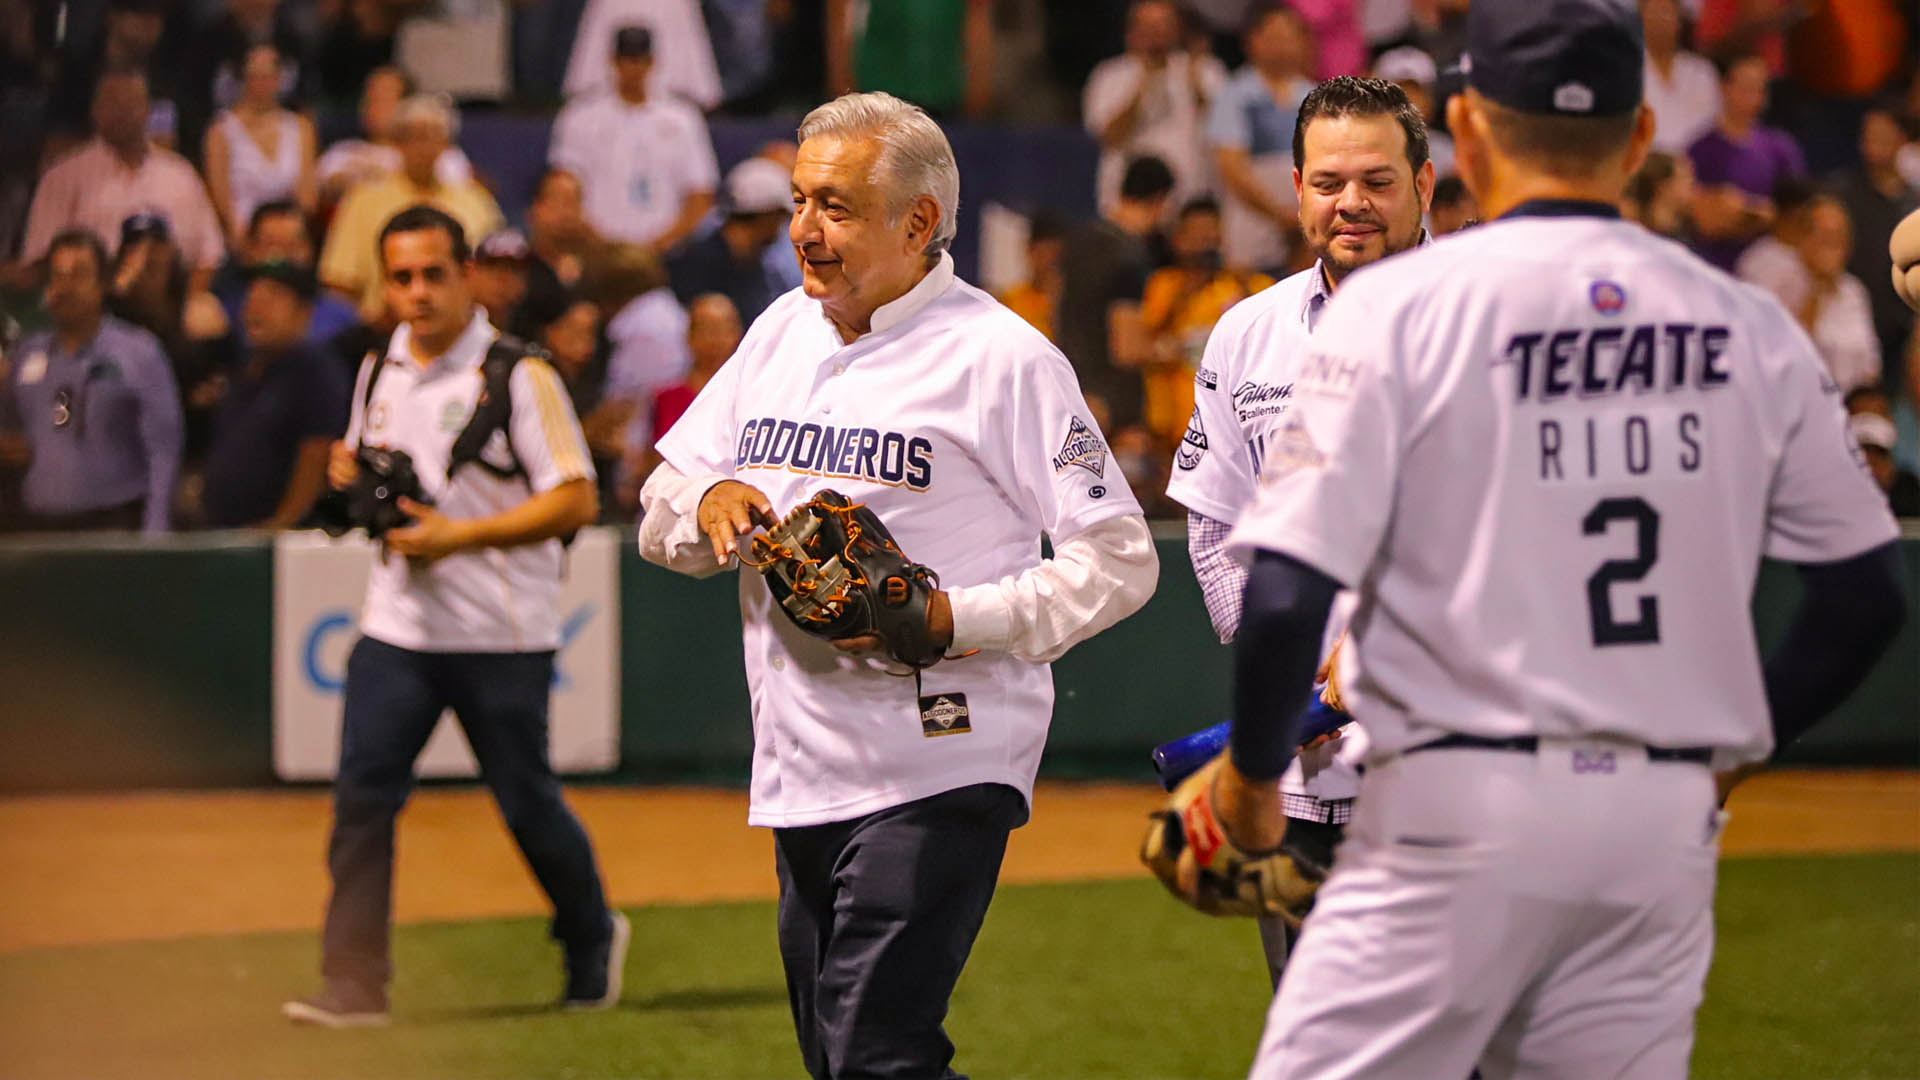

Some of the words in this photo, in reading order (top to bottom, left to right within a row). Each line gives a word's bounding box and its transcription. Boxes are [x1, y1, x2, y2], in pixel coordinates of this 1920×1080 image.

[1506, 322, 1731, 401] TECATE
[1540, 412, 1702, 480] RIOS
[1582, 497, 1660, 646] 2
